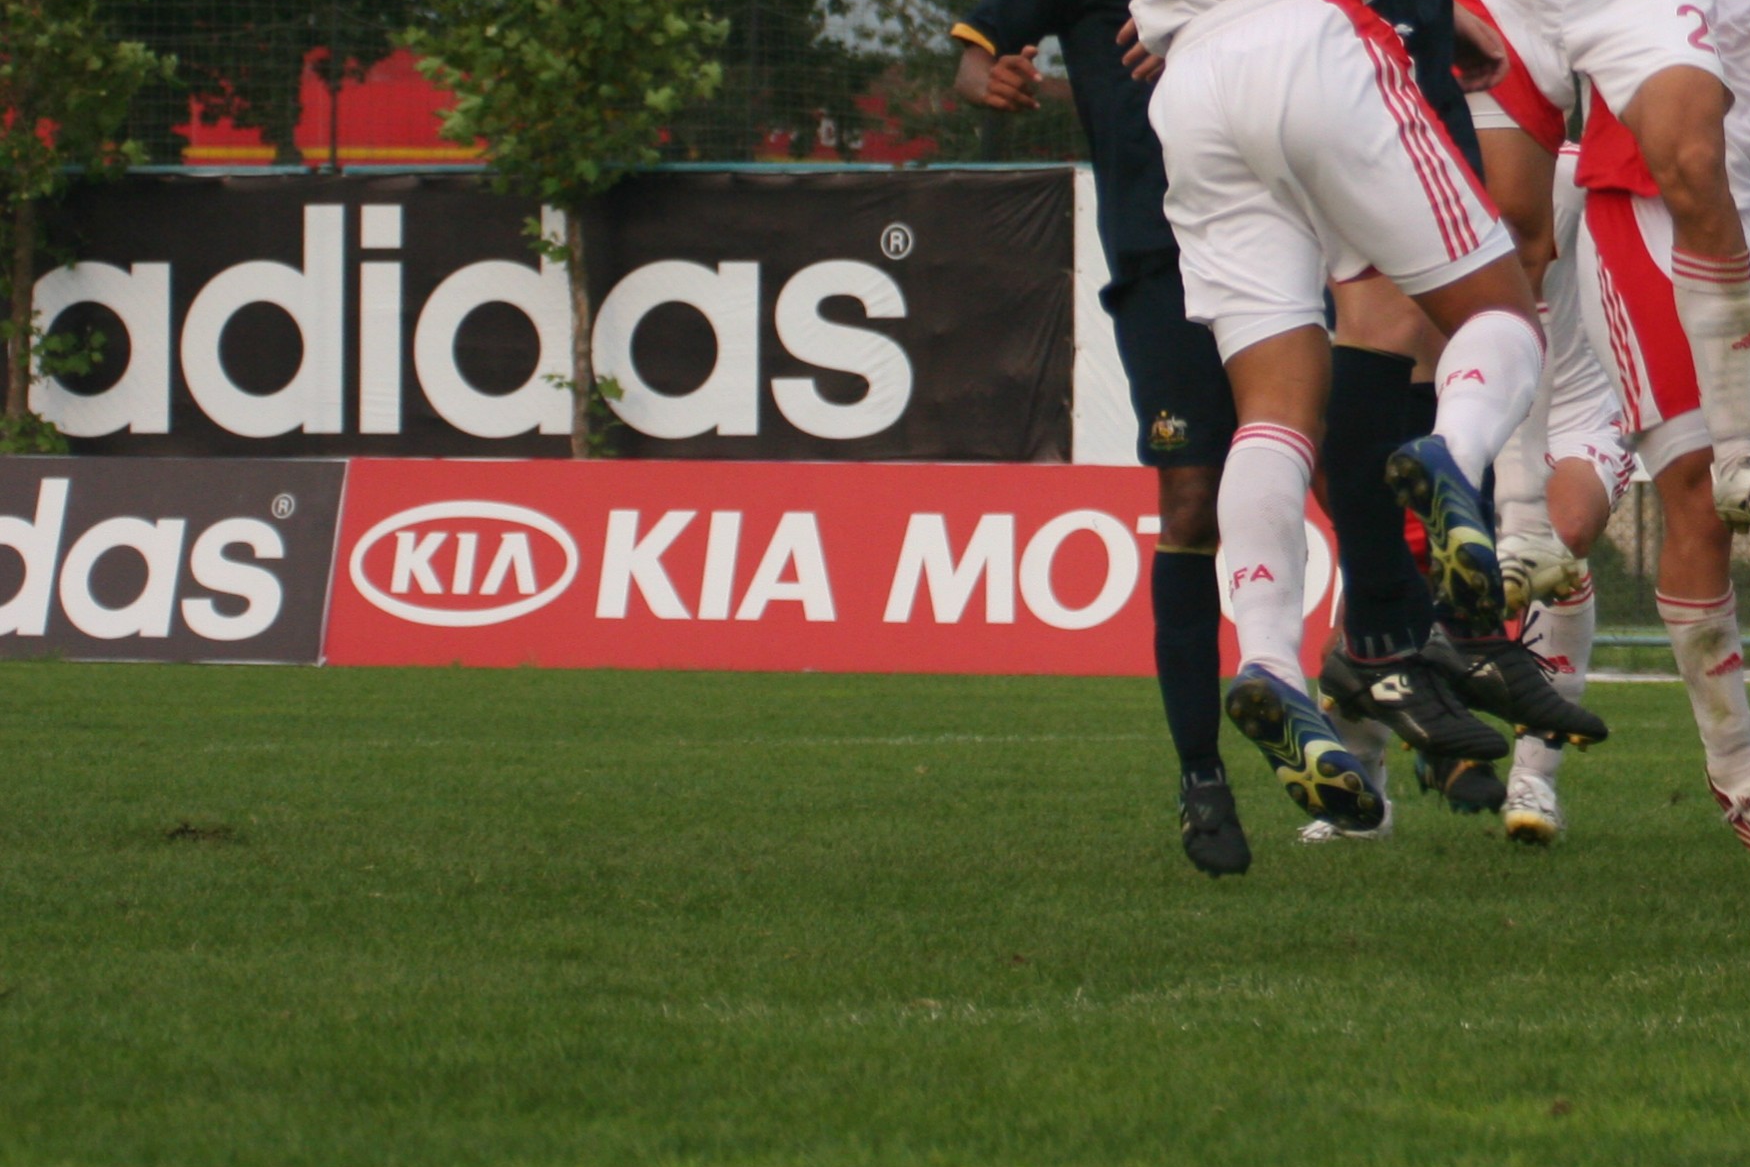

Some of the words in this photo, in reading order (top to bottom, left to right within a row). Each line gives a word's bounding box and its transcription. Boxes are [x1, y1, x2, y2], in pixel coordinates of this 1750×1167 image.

[1676, 4, 1717, 54] 2
[28, 203, 913, 440] adidas
[1438, 368, 1486, 397] FA
[391, 532, 538, 595] KIA
[595, 509, 836, 622] KIA
[1230, 564, 1275, 599] FA
